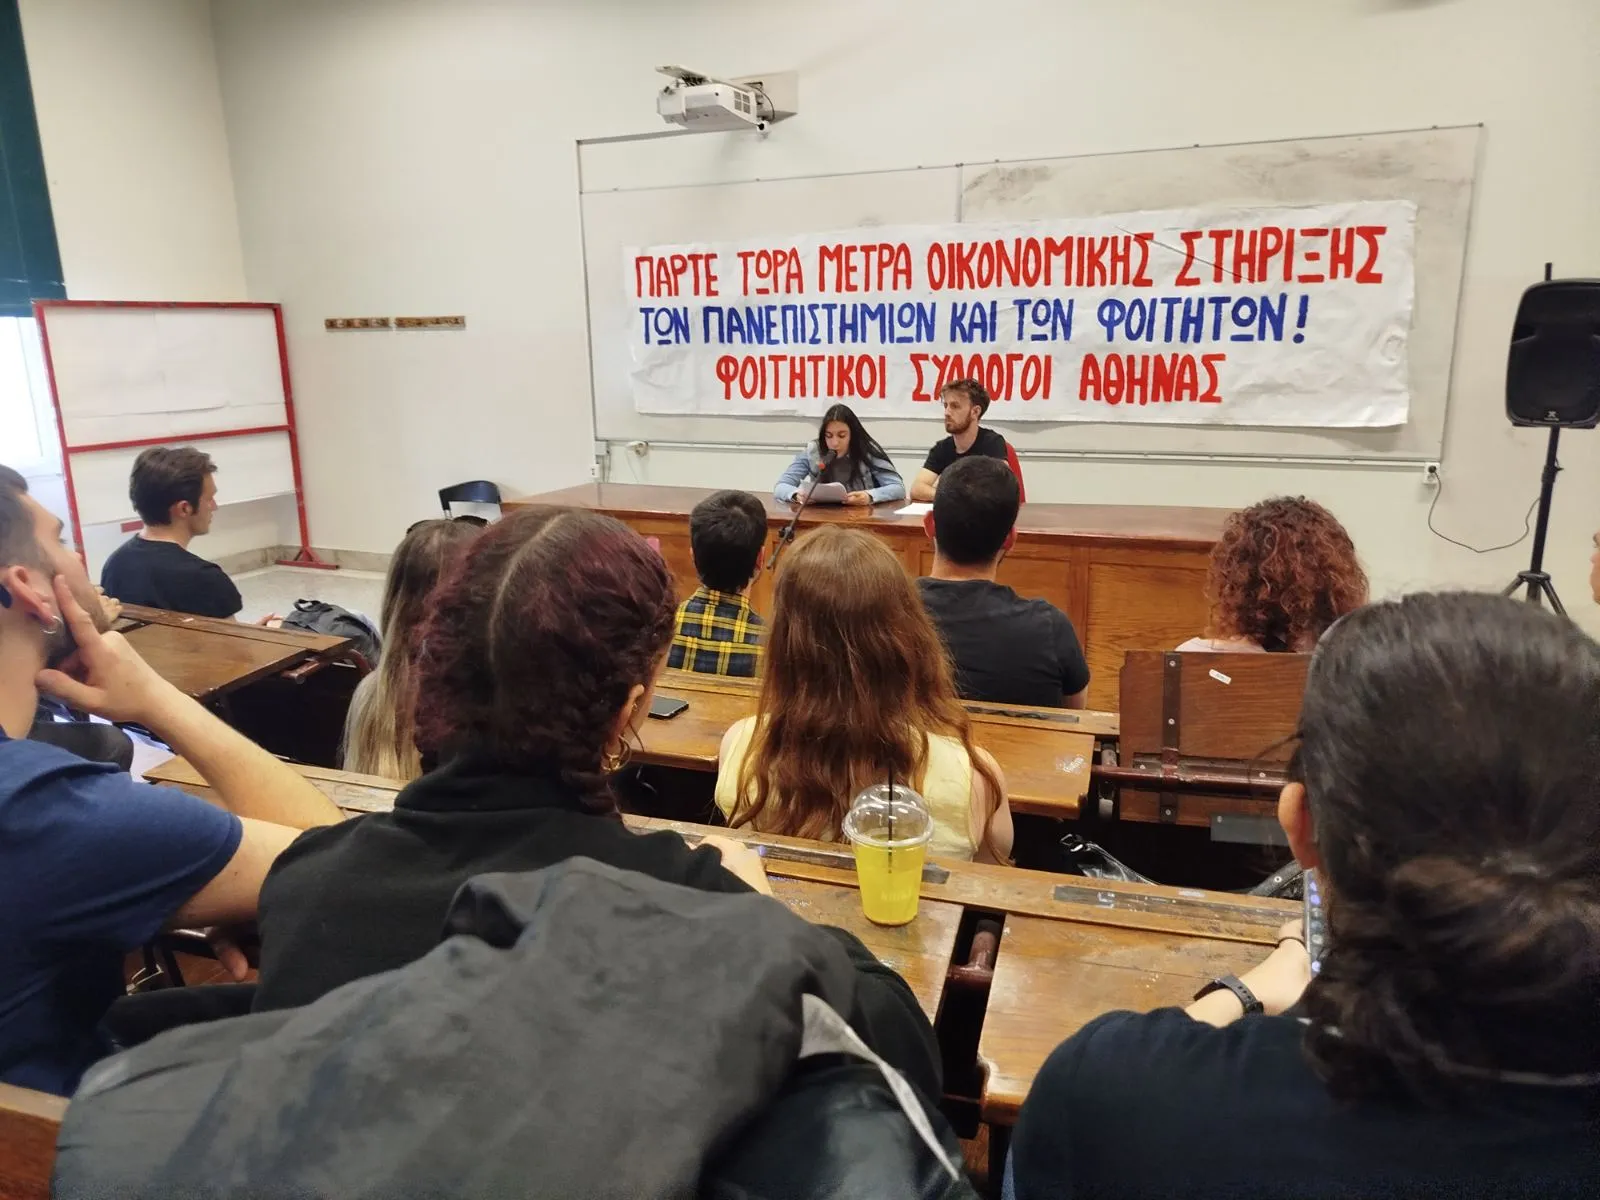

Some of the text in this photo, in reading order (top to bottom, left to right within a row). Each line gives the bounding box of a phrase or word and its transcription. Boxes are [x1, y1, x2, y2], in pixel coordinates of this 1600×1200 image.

[635, 225, 1387, 297] ΠΑΡΤΕ ΤΩΡΑ ΜΕΤΡΑ ΟΙΚΟΝΟΜΙΚΗΣ ΣΤΗΡΙΞΗΣ
[639, 293, 1309, 345] ΤΩΝ ΠΑΝΕΠΙΣΤΗΜΙΩΝ ΚΑΙ ΤΩΝ ΦΟΙΤΗΤΩΝ!
[715, 354, 886, 401] ΦΟΙΤΗΤΙΚΟΙ
[1079, 353, 1226, 406] ΑΘΗΝΑΣ
